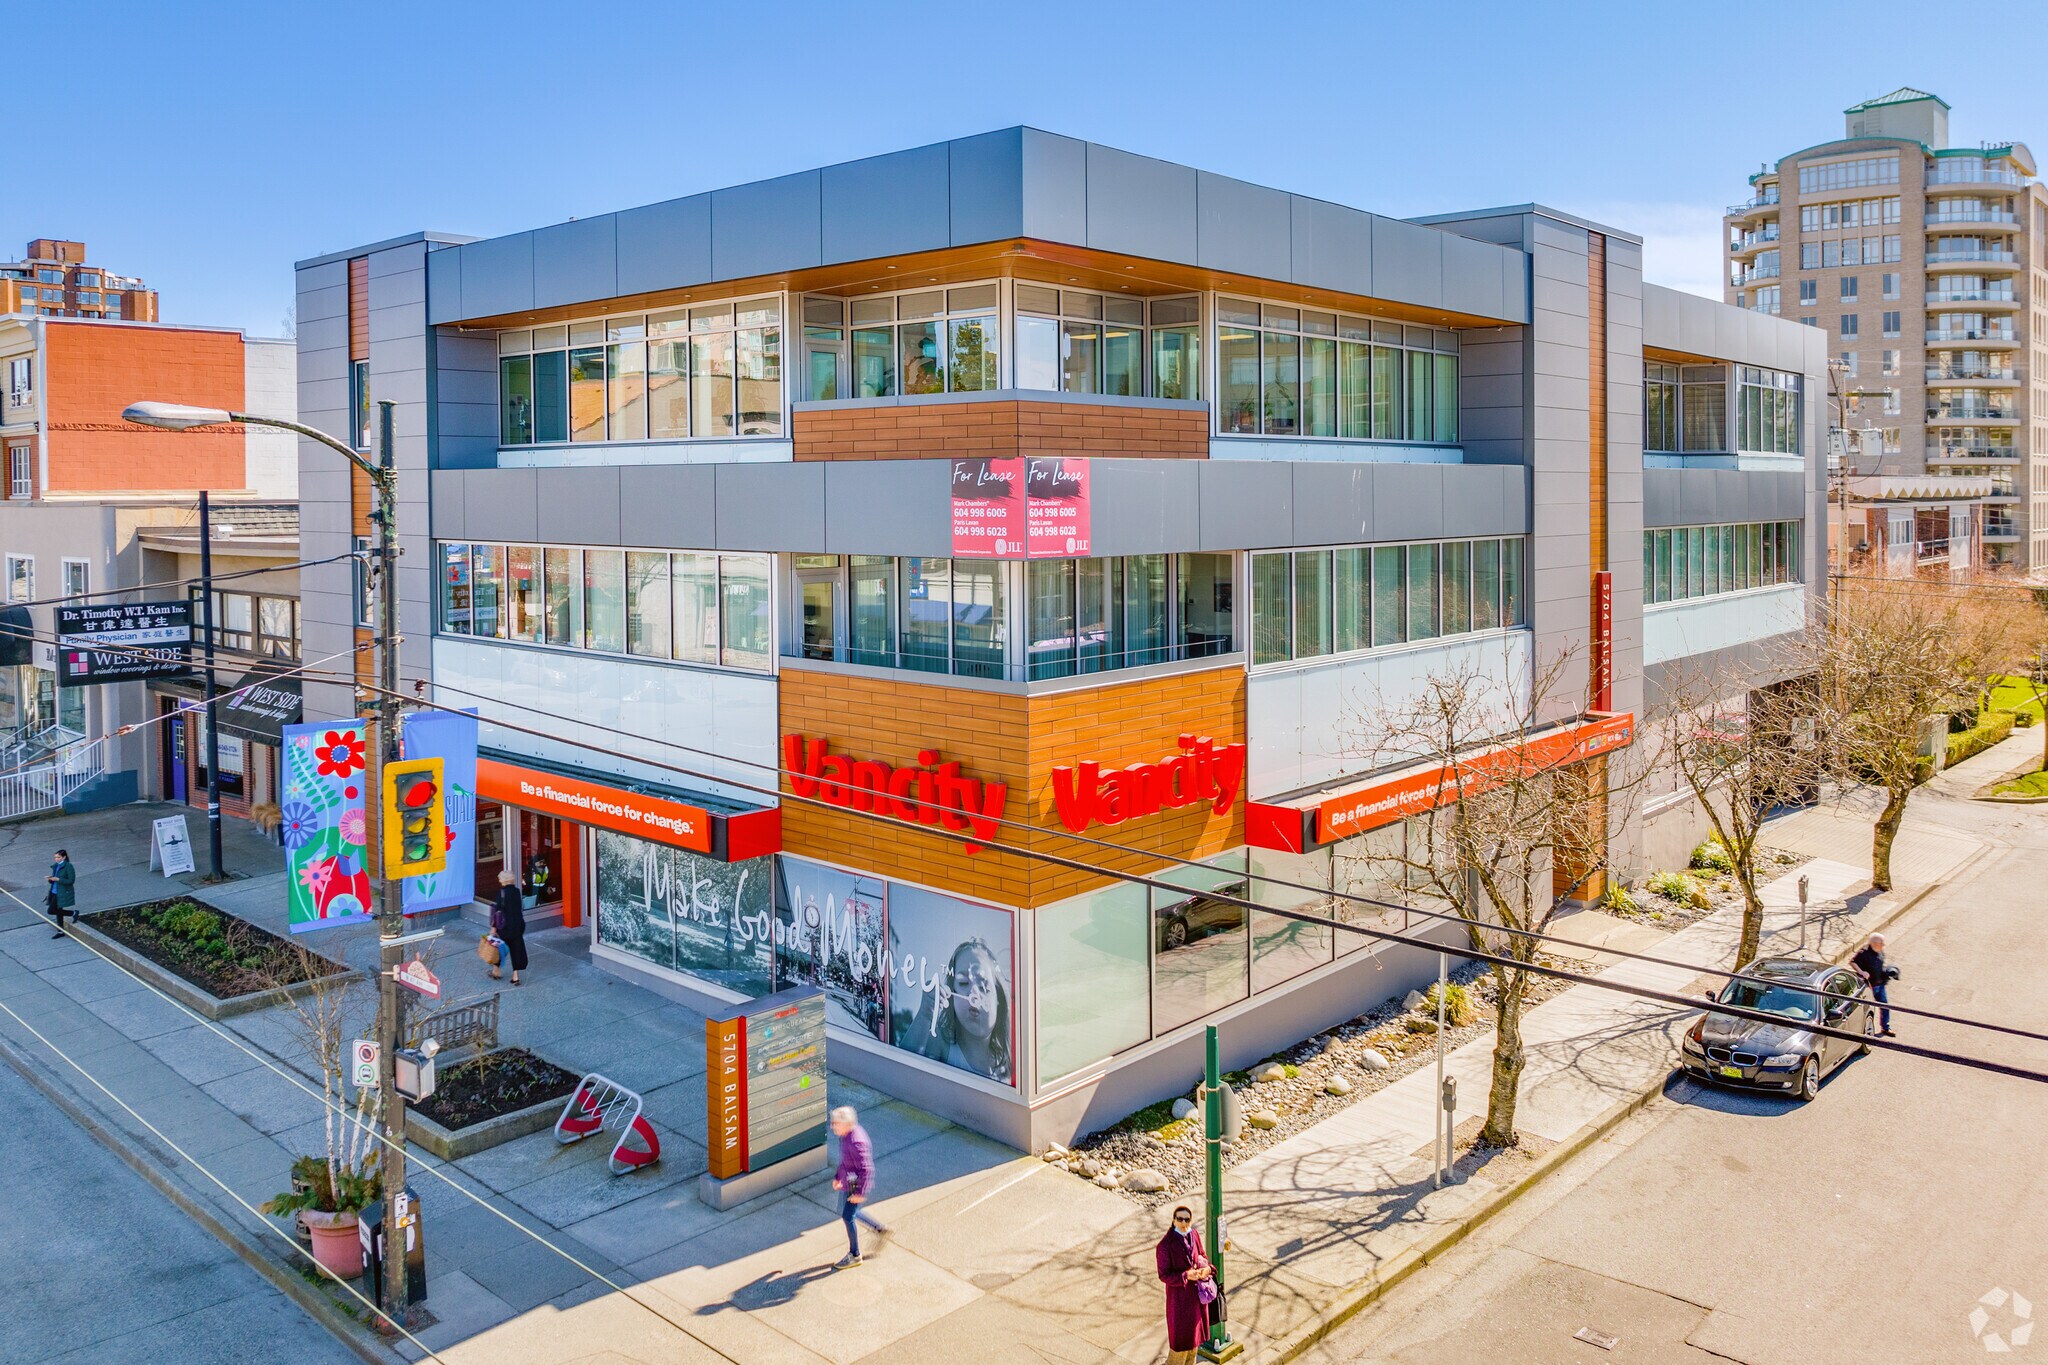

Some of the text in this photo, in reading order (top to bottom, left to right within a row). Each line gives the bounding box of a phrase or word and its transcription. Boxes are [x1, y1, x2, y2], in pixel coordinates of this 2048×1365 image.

[953, 462, 1016, 486] For Lease
[1028, 460, 1084, 486] For Lease
[954, 508, 1007, 518] 604 998 6005
[1030, 508, 1076, 517] 604 998 6005
[954, 526, 1007, 536] 604 998 6028
[1030, 526, 1076, 536] 604 998 6028
[63, 611, 79, 620] Dr.
[81, 608, 122, 620] Timothy
[124, 606, 145, 617] W.T.
[147, 606, 171, 615] Kam
[97, 633, 137, 644] Physician
[94, 647, 182, 666] WEST SIDE
[93, 665, 120, 675] window
[161, 662, 181, 672] design
[250, 686, 303, 709] WEST SIDE
[783, 733, 1006, 856] Vancity
[1052, 732, 1246, 834] Vancity
[520, 781, 535, 795] Be
[536, 786, 543, 797] a
[543, 786, 590, 808] financial
[590, 797, 623, 817] force
[624, 805, 642, 821] for
[1331, 812, 1347, 826] Be
[1347, 809, 1354, 822] a
[1355, 794, 1399, 818] financial
[1399, 789, 1425, 805] force
[1425, 784, 1439, 797] for
[643, 843, 721, 932] Make
[735, 868, 811, 952] Good
[724, 1033, 737, 1150] 5704 BALSAM
